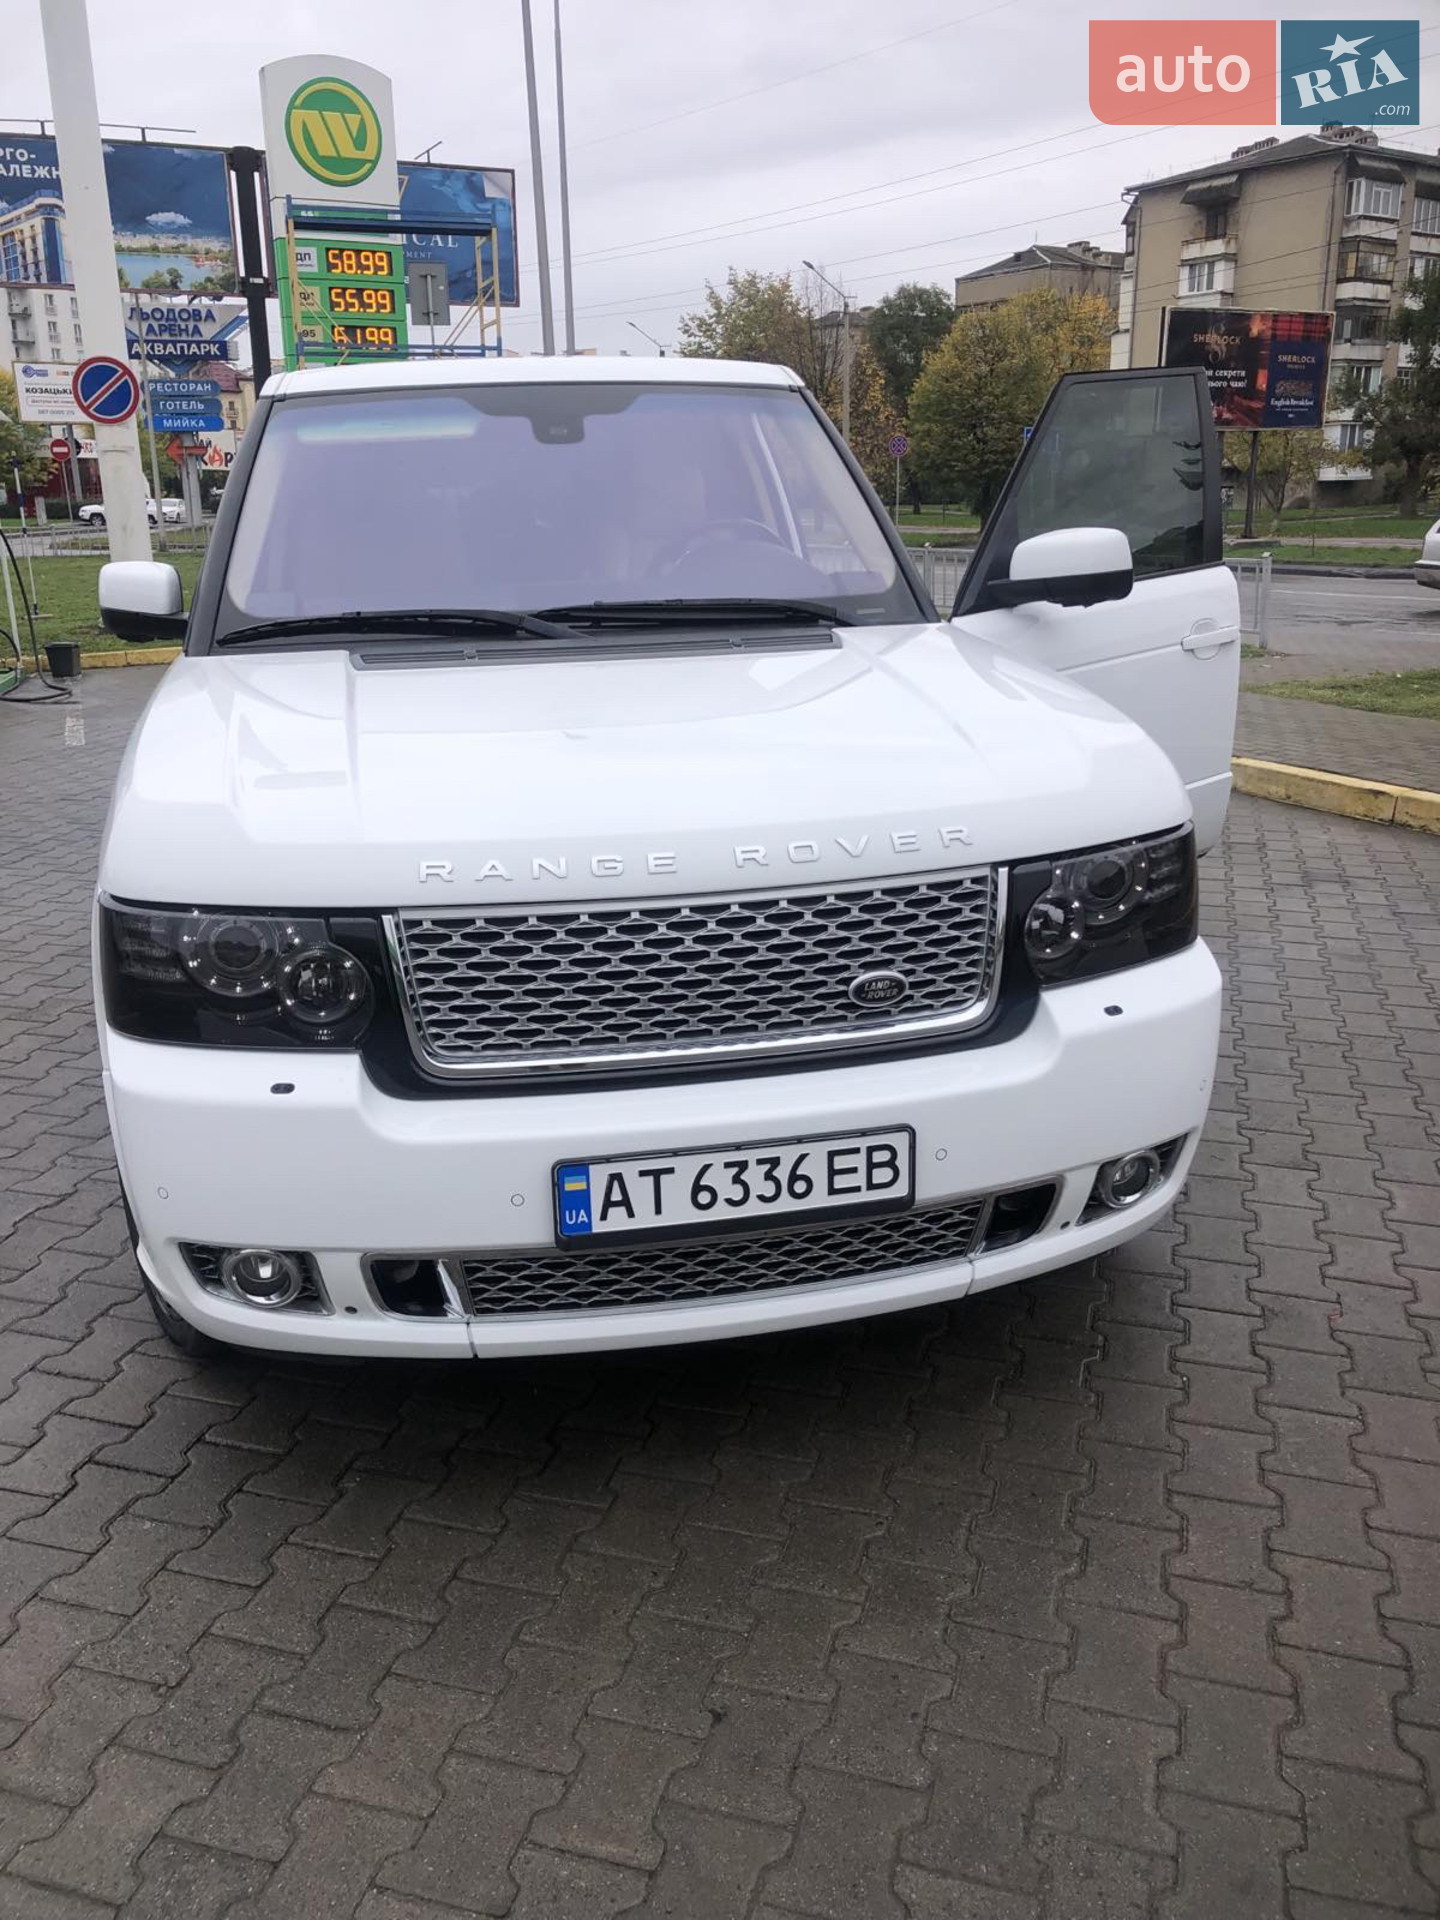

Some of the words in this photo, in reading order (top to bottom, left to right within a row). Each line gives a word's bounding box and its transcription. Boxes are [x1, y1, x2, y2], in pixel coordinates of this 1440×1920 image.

[328, 249, 388, 276] 58.99
[330, 288, 391, 313] 55.99
[128, 307, 216, 323] ЛЬОДОВА
[145, 323, 203, 338] АРЕНА
[1193, 333, 1241, 345] SHERLOCK
[131, 342, 220, 355] АКВАПАРК
[149, 383, 212, 393] РЕСТОРАН
[160, 401, 205, 410] ГОТЕЛЬ
[163, 416, 206, 428] МИЙКА
[418, 852, 678, 882] RANGE
[733, 826, 973, 867] ROVER
[690, 1152, 814, 1212] 6336
[565, 1210, 589, 1225] UA
